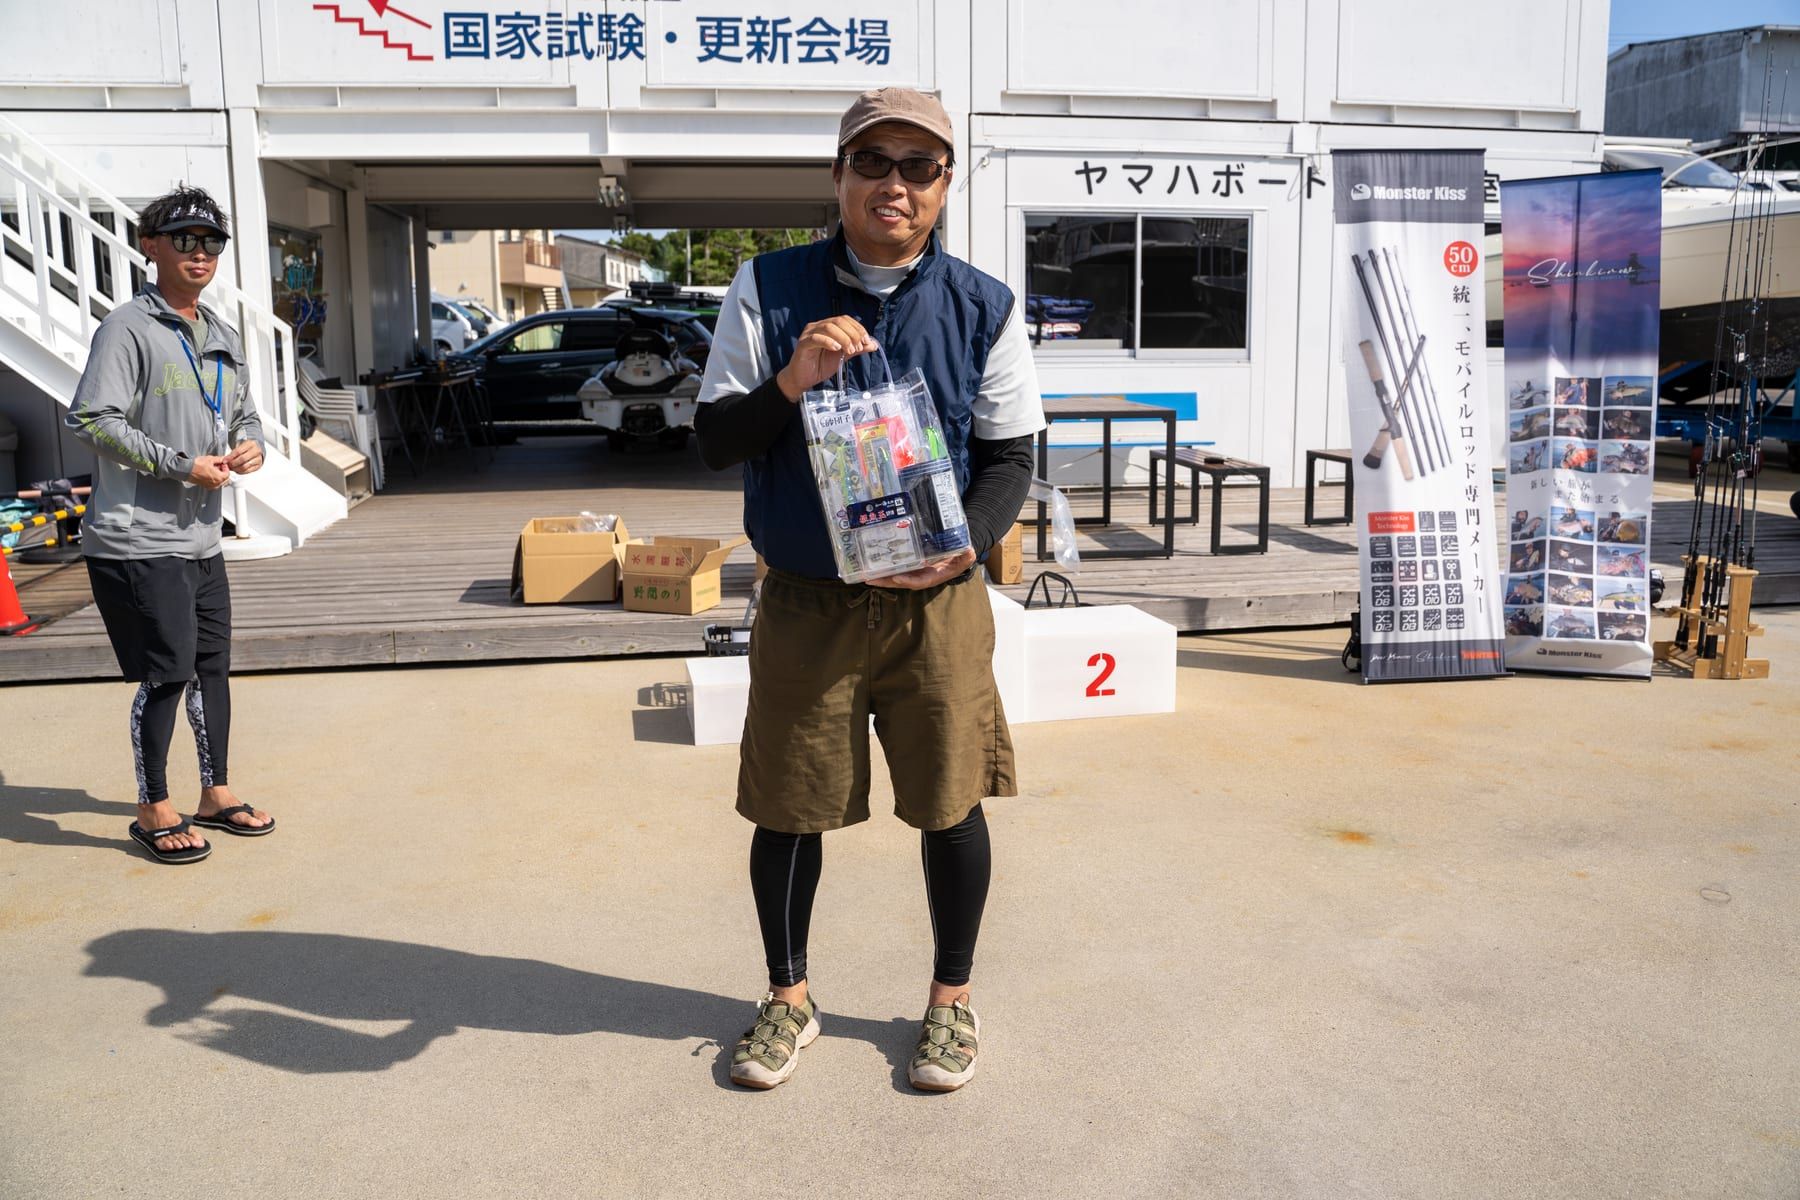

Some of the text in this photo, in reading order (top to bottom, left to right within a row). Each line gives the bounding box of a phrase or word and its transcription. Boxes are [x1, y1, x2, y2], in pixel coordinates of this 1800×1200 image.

[443, 13, 892, 66] 国家試験・更新会場
[1373, 186, 1467, 201] Monster Kiss
[1448, 246, 1473, 264] 50
[1450, 263, 1471, 274] cm
[1402, 598, 1416, 606] D9
[1424, 596, 1440, 605] D10
[1375, 623, 1393, 631] D12
[1548, 649, 1583, 657] Monster
[1086, 653, 1115, 697] 2
